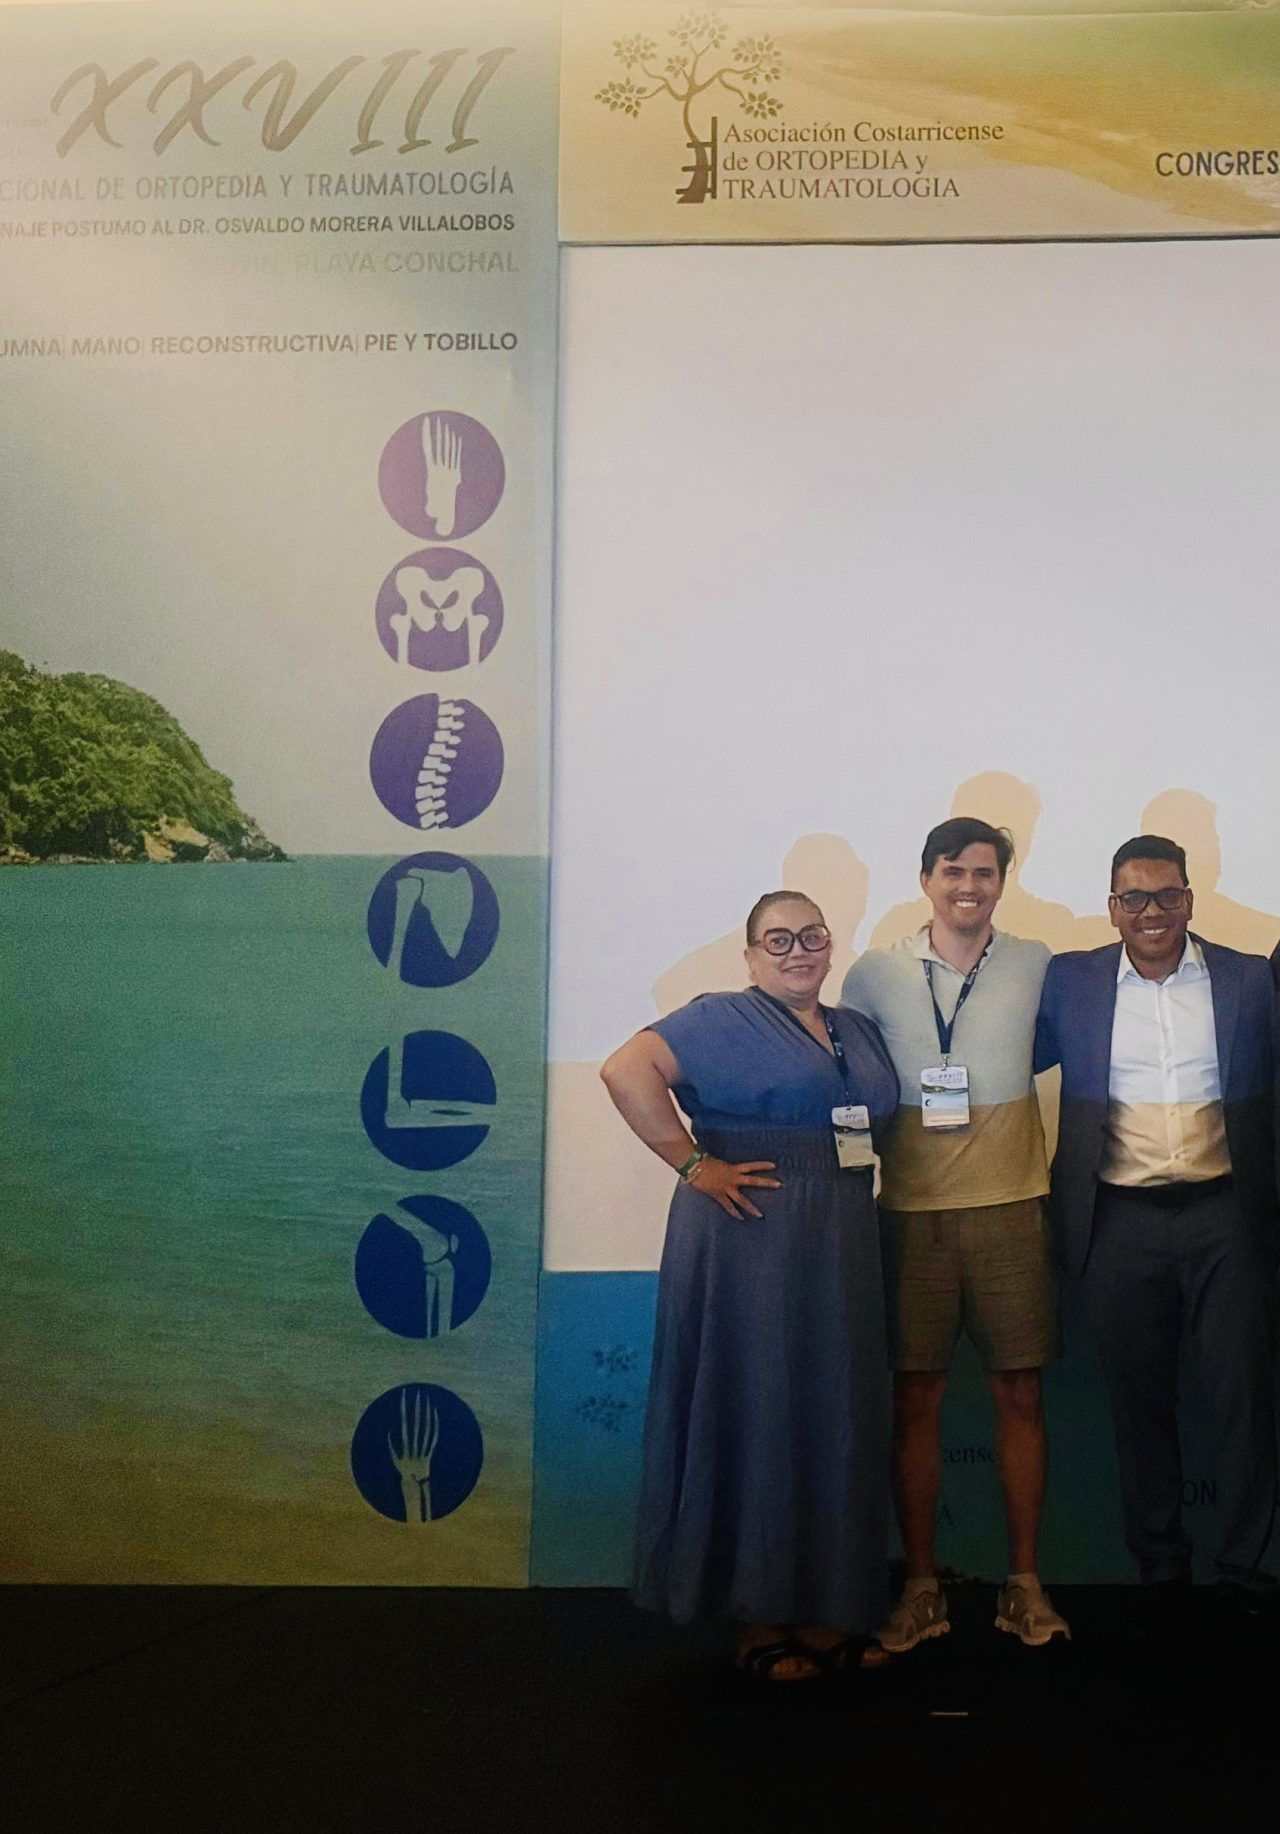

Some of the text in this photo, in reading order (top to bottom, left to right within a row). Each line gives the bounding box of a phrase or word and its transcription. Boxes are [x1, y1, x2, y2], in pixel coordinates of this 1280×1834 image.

[50, 46, 516, 159] XXVIII
[723, 120, 1005, 144] Asociación Costarricense
[723, 149, 928, 175] de ORTOPEDIA y
[97, 177, 124, 200] DE
[136, 174, 267, 200] ORTOPEDIA
[280, 174, 292, 198] Y
[306, 165, 515, 198] TRAUMATOLOGÍA
[723, 176, 961, 200] TRAUMATOLOGIA
[52, 219, 146, 238] POSTUMO
[151, 218, 174, 236] AL
[215, 216, 304, 234] OSVALDO
[310, 215, 394, 233] MORERA
[399, 213, 515, 232] VILLALOBOS
[295, 252, 376, 274] PLAYA
[384, 251, 519, 273] CONCHAL
[364, 333, 397, 351] PIE
[404, 333, 416, 350] Y
[424, 332, 518, 351] TOBILLO
